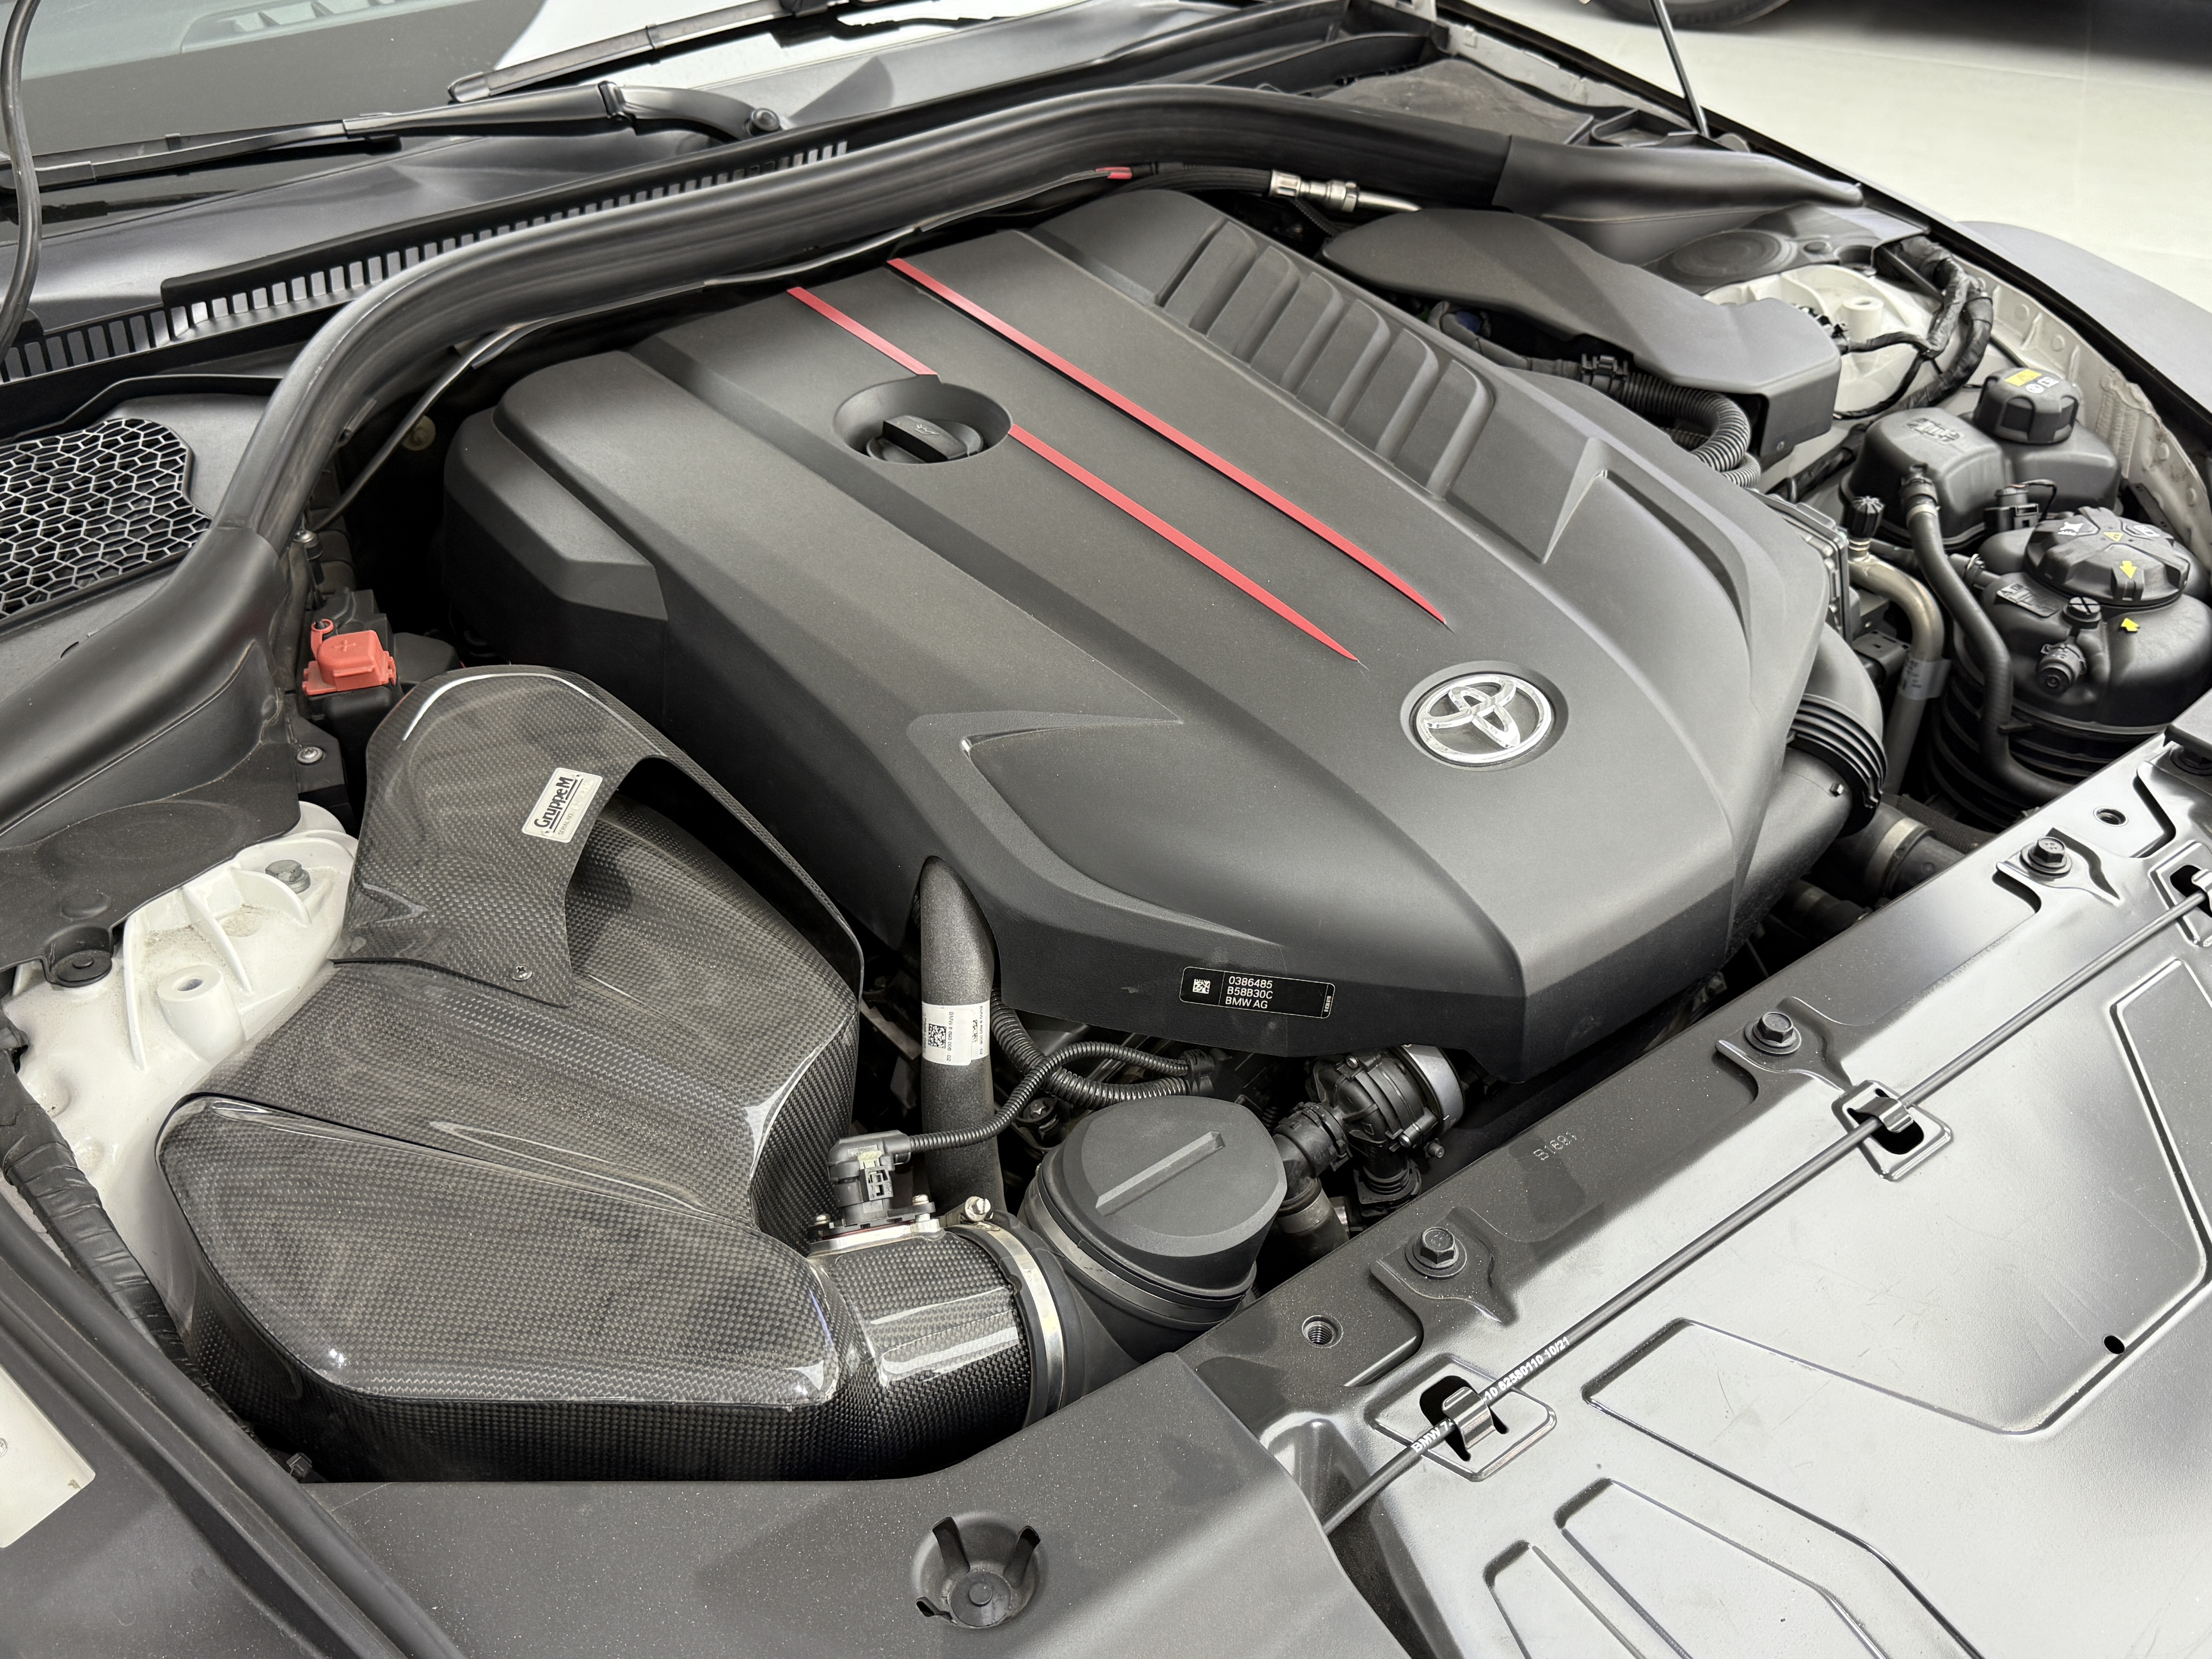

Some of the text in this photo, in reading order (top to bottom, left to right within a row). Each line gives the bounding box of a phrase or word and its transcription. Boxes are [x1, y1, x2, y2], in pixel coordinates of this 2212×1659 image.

[534, 776, 574, 828] GruppeM
[1228, 976, 1273, 989] 0386485
[1227, 986, 1273, 999] B58B30C
[1225, 996, 1268, 1009] BMW AG
[1410, 1427, 1441, 1453] BMW
[1544, 1336, 1570, 1358] 10/21
